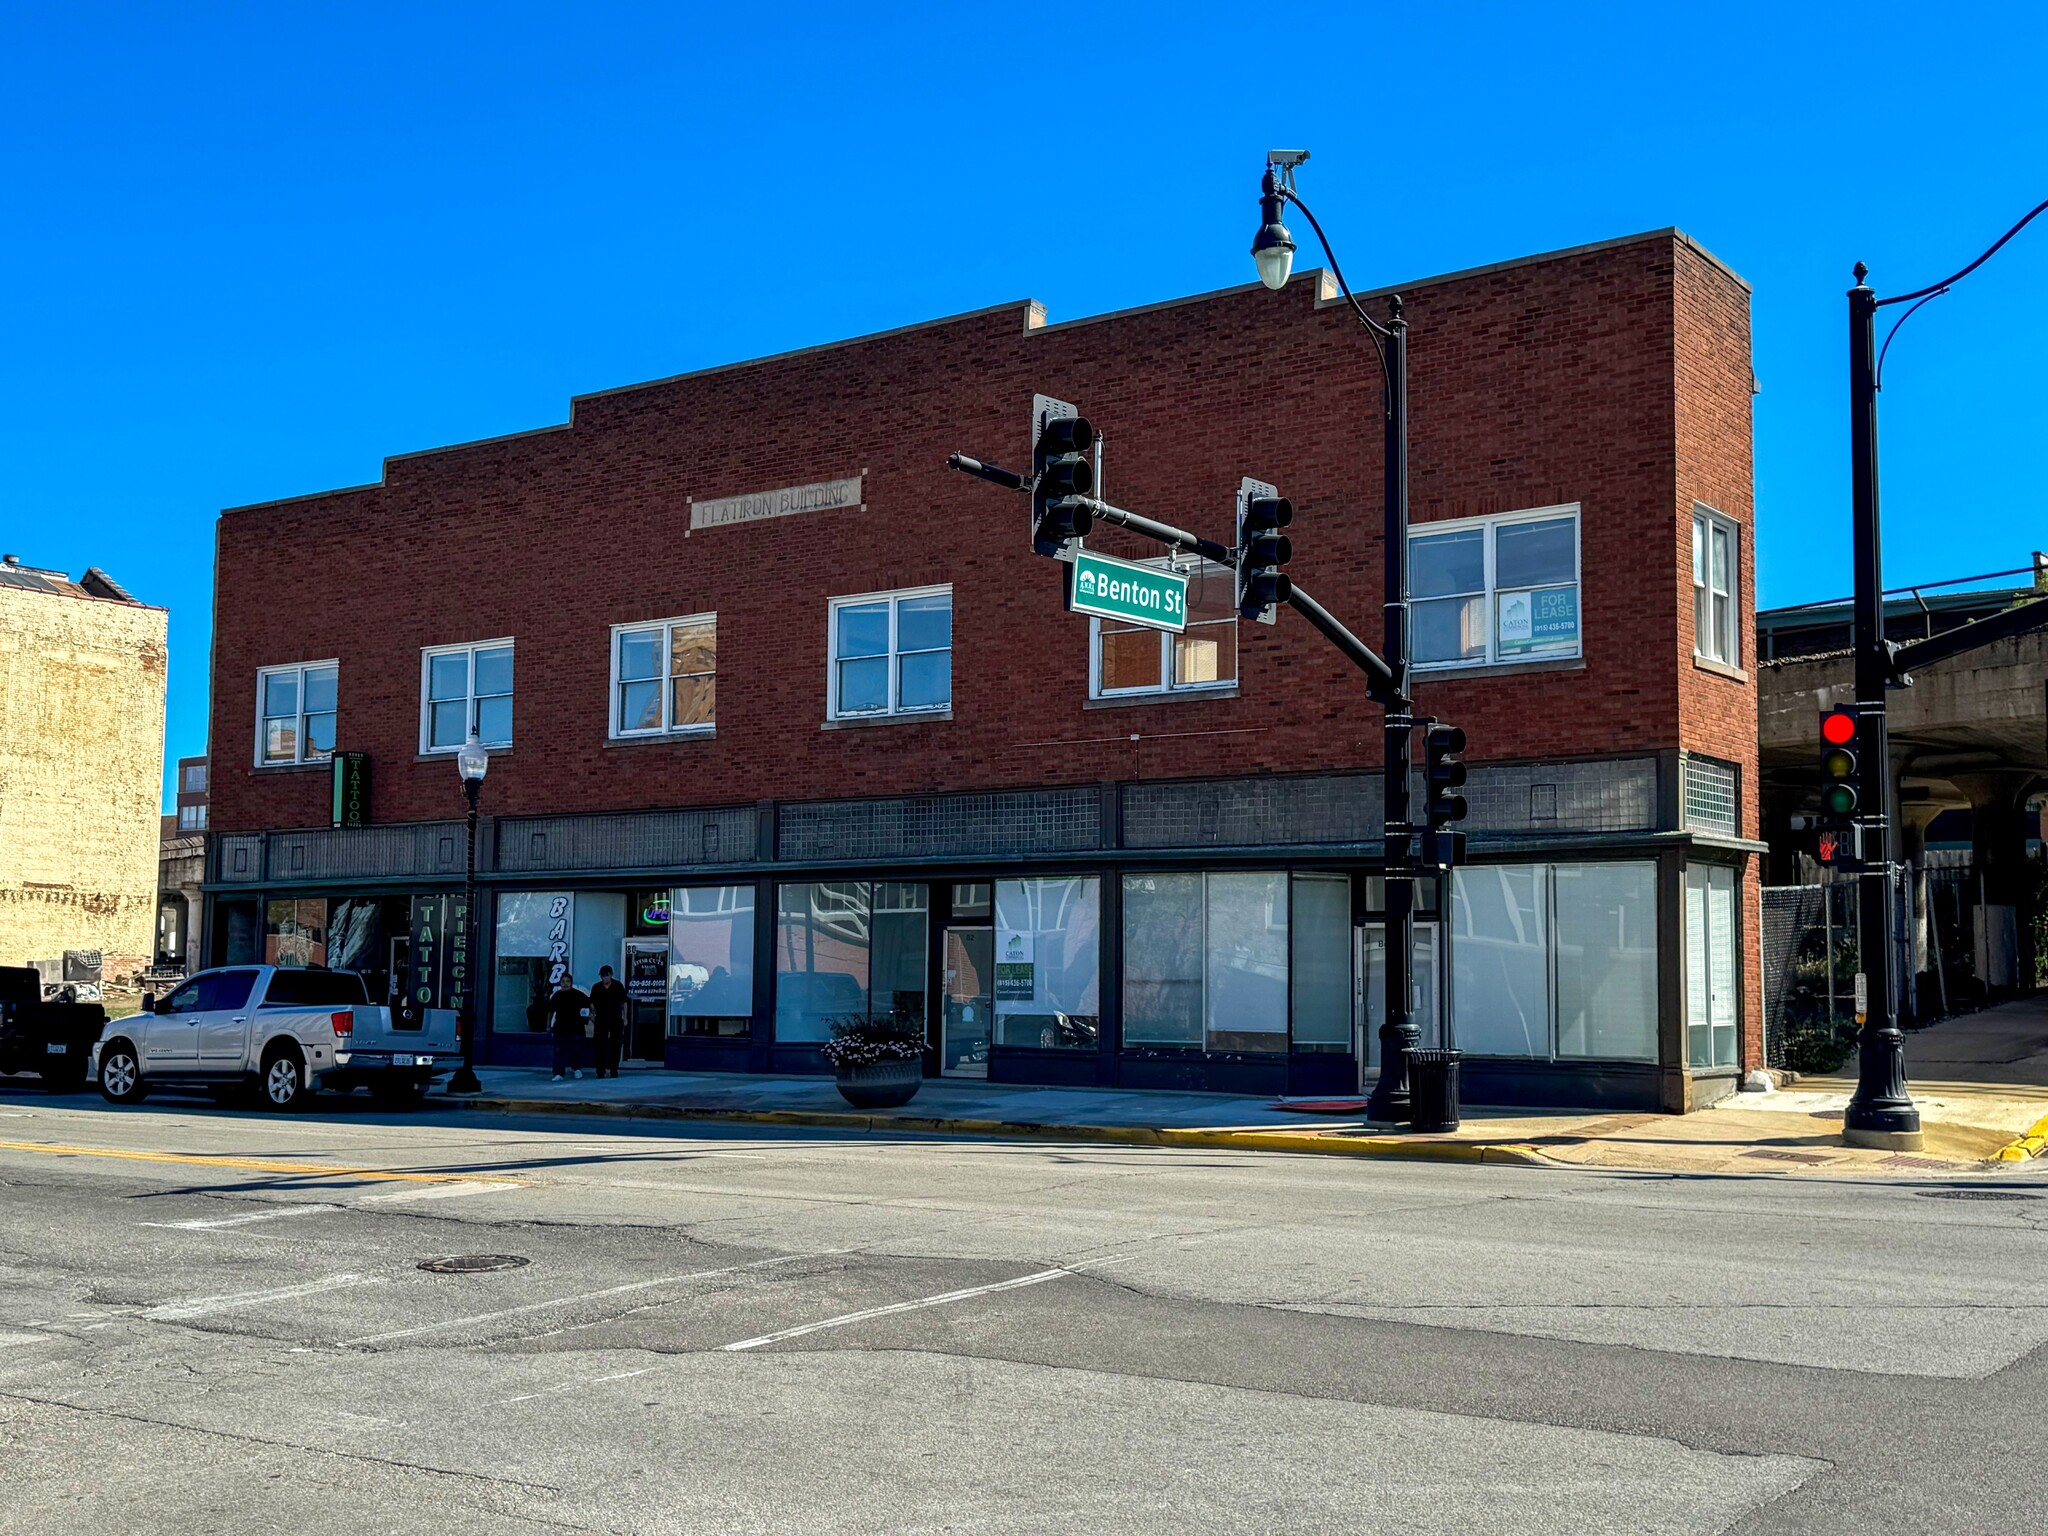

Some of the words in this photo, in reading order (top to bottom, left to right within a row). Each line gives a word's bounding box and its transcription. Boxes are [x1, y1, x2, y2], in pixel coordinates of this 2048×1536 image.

[702, 496, 772, 524] FLATIRON
[1097, 573, 1160, 610] Benton
[1164, 589, 1182, 614] St
[1541, 594, 1566, 607] FOR
[1503, 618, 1529, 628] CATON
[1534, 605, 1574, 619] LEASE
[349, 760, 361, 820] TATTOO
[416, 905, 434, 1004] TATTO
[450, 905, 467, 1009] PIERCIN
[998, 964, 1011, 974] FOR
[1012, 964, 1033, 974] LEASE
